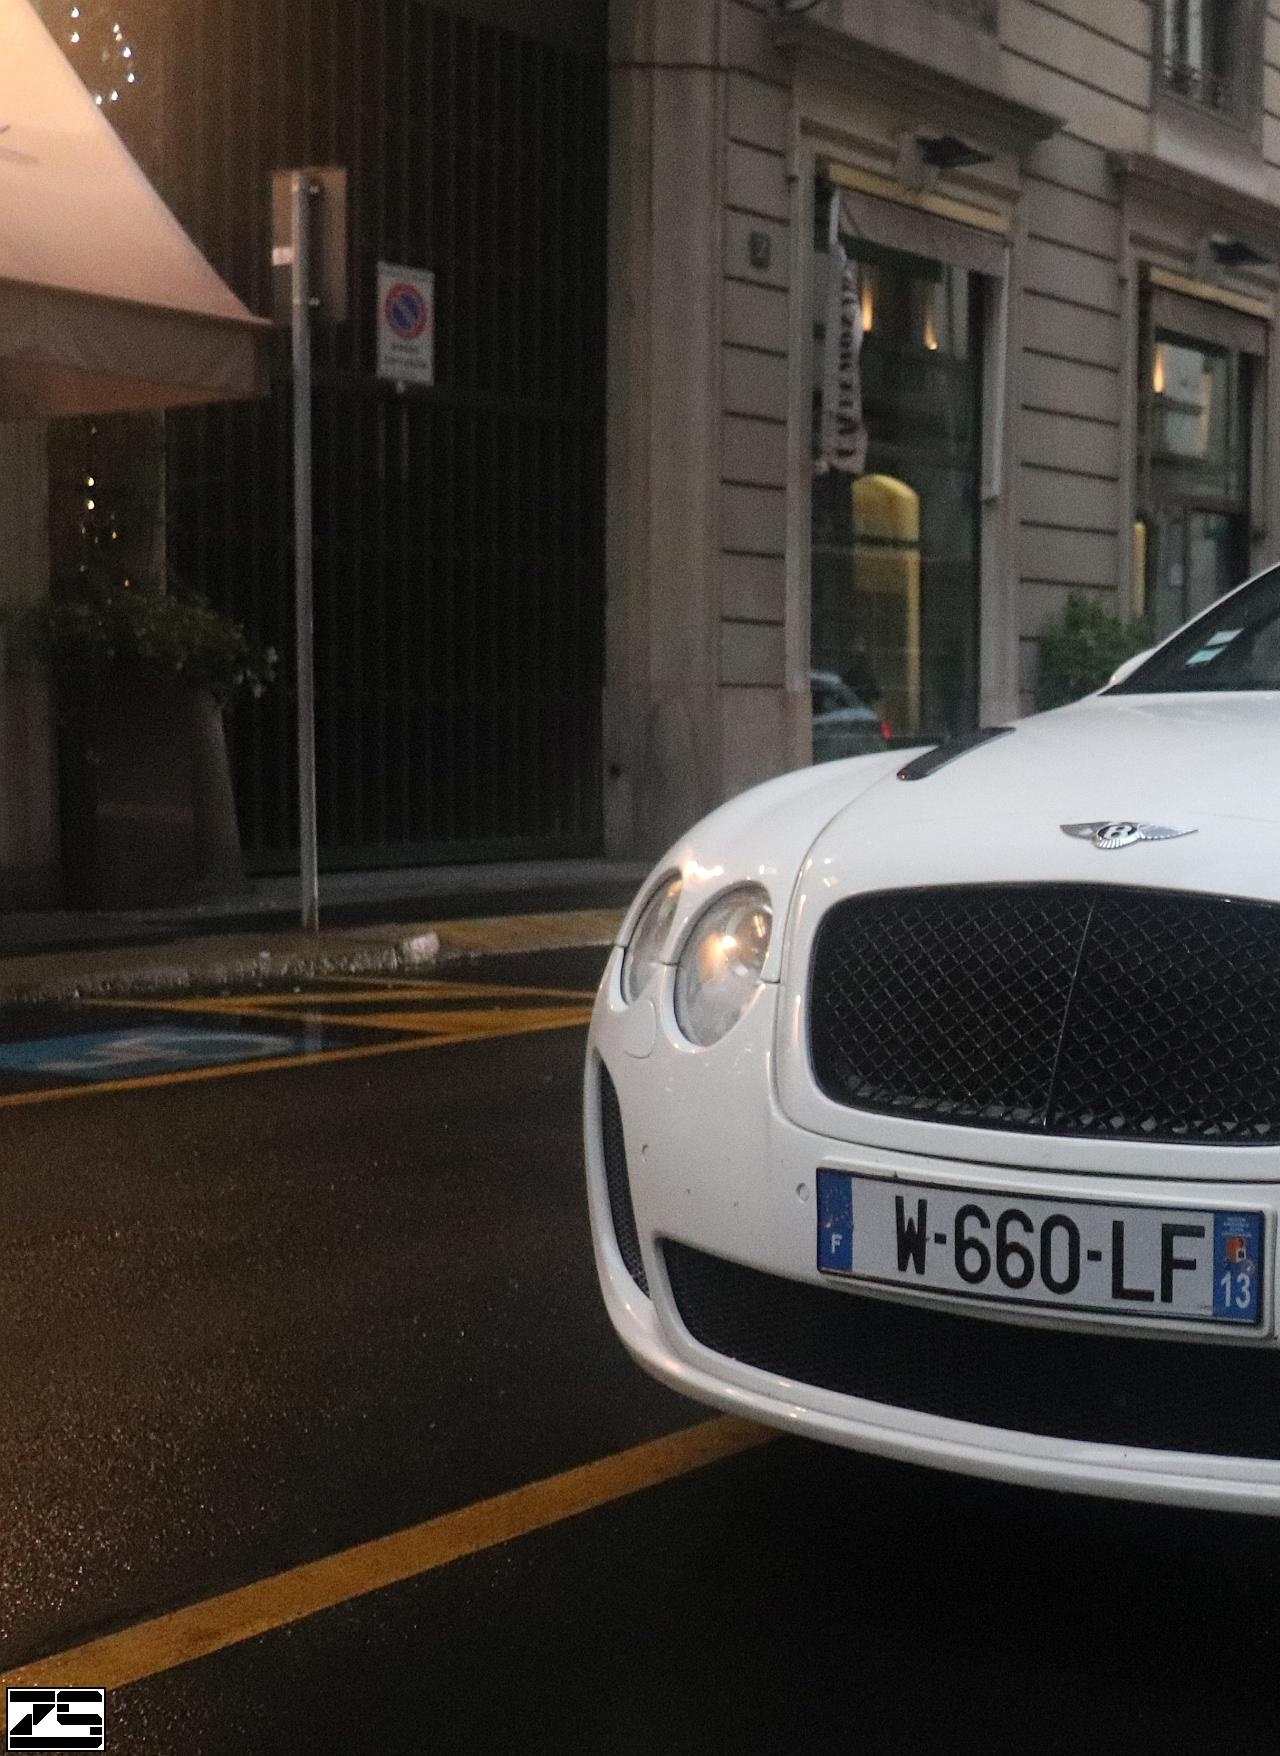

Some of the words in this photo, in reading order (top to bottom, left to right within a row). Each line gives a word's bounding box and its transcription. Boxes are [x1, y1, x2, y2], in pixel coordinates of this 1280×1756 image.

[830, 1234, 843, 1254] F
[895, 1195, 1206, 1303] W-660-LF
[1219, 1272, 1252, 1309] 13
